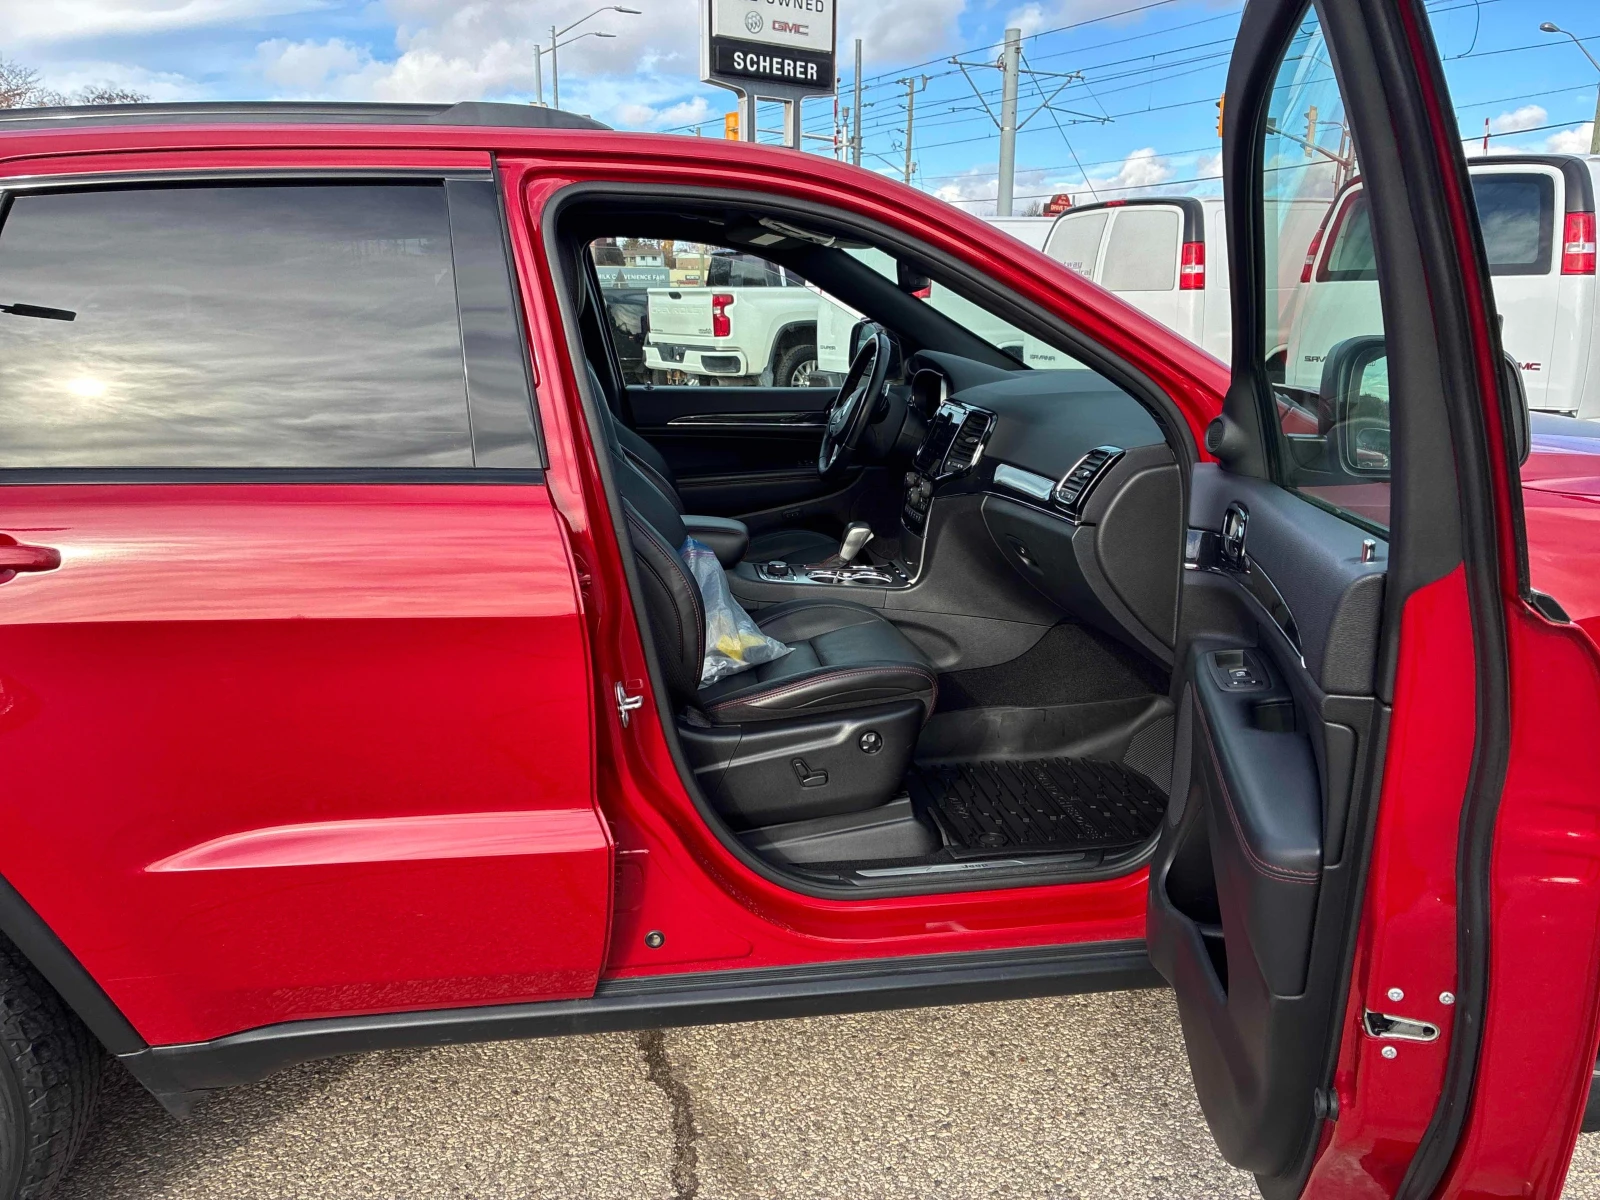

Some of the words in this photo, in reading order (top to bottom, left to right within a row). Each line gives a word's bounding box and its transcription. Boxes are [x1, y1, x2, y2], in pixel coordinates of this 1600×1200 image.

[772, 20, 809, 36] GMC
[733, 51, 818, 80] SCHERER
[1518, 362, 1541, 371] MC
